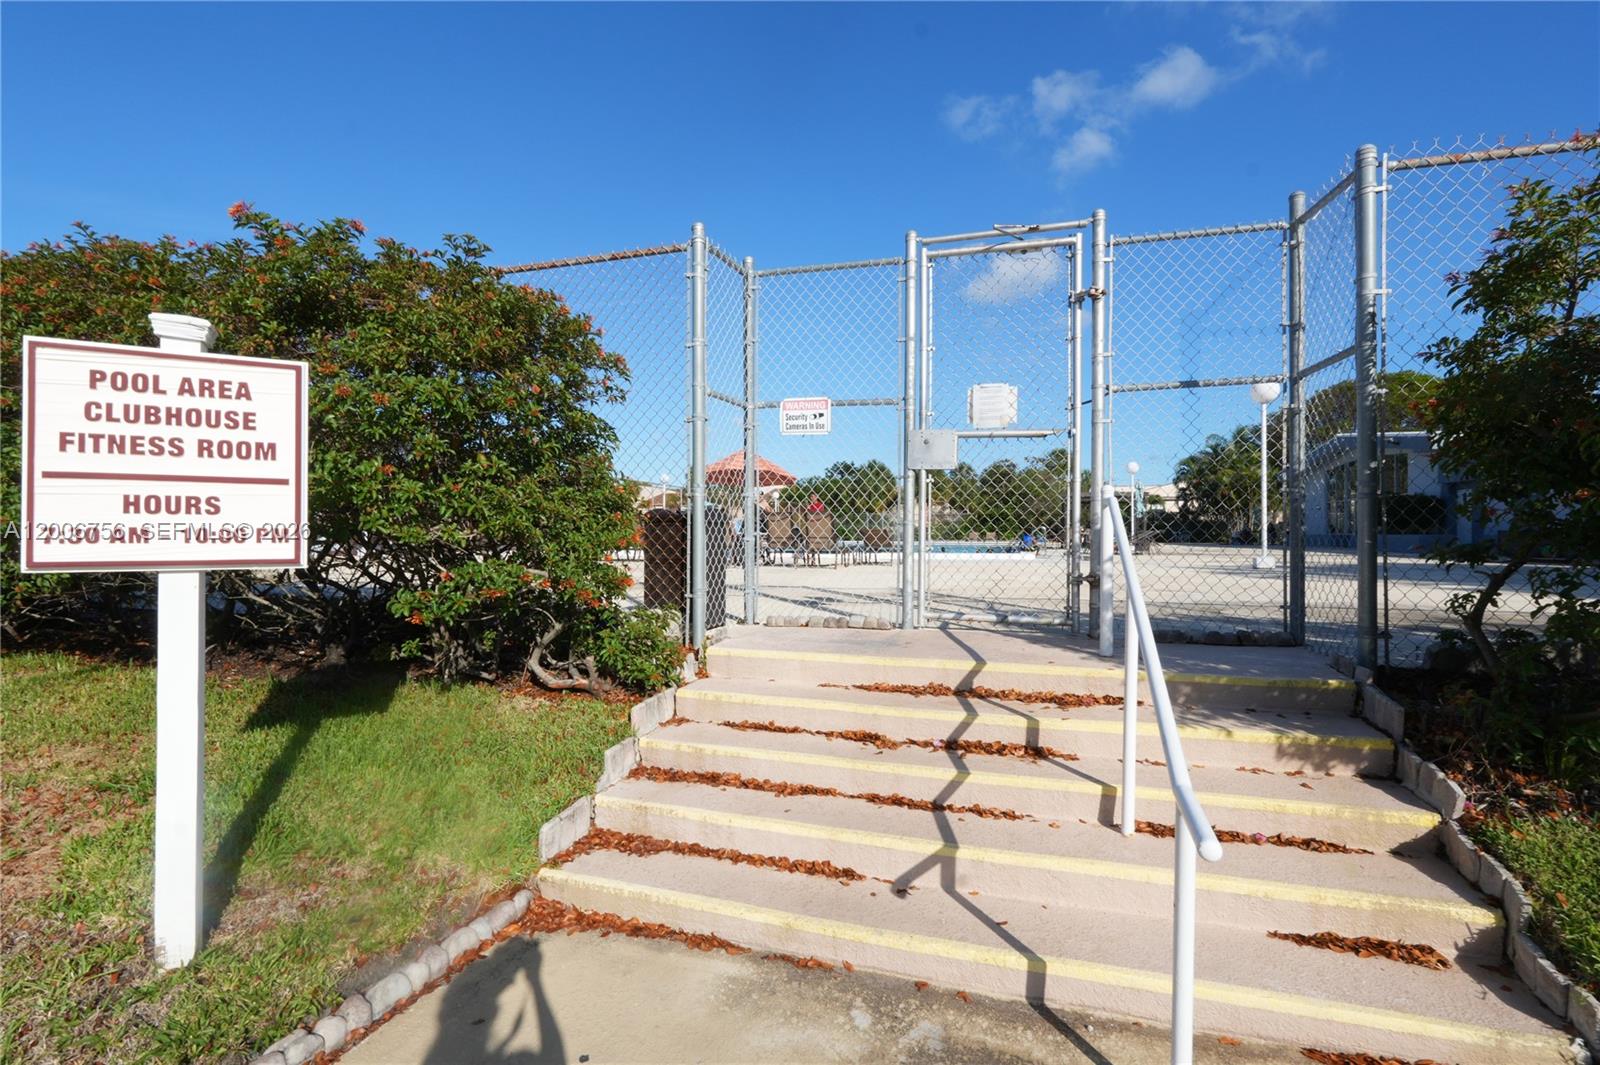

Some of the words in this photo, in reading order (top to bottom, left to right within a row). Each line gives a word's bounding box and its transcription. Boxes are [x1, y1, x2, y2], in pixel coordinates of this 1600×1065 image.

[88, 369, 167, 396] POOL
[177, 376, 253, 401] AREA
[784, 401, 827, 410] WARNING
[84, 401, 257, 431] CLUBHOUSE
[785, 413, 808, 421] Security
[785, 422, 808, 430] Cameras
[58, 431, 185, 458] FITNESS
[197, 438, 278, 461] ROOM
[122, 494, 222, 516] HOURS
[110, 527, 150, 544] AM
[255, 527, 290, 543] PM
